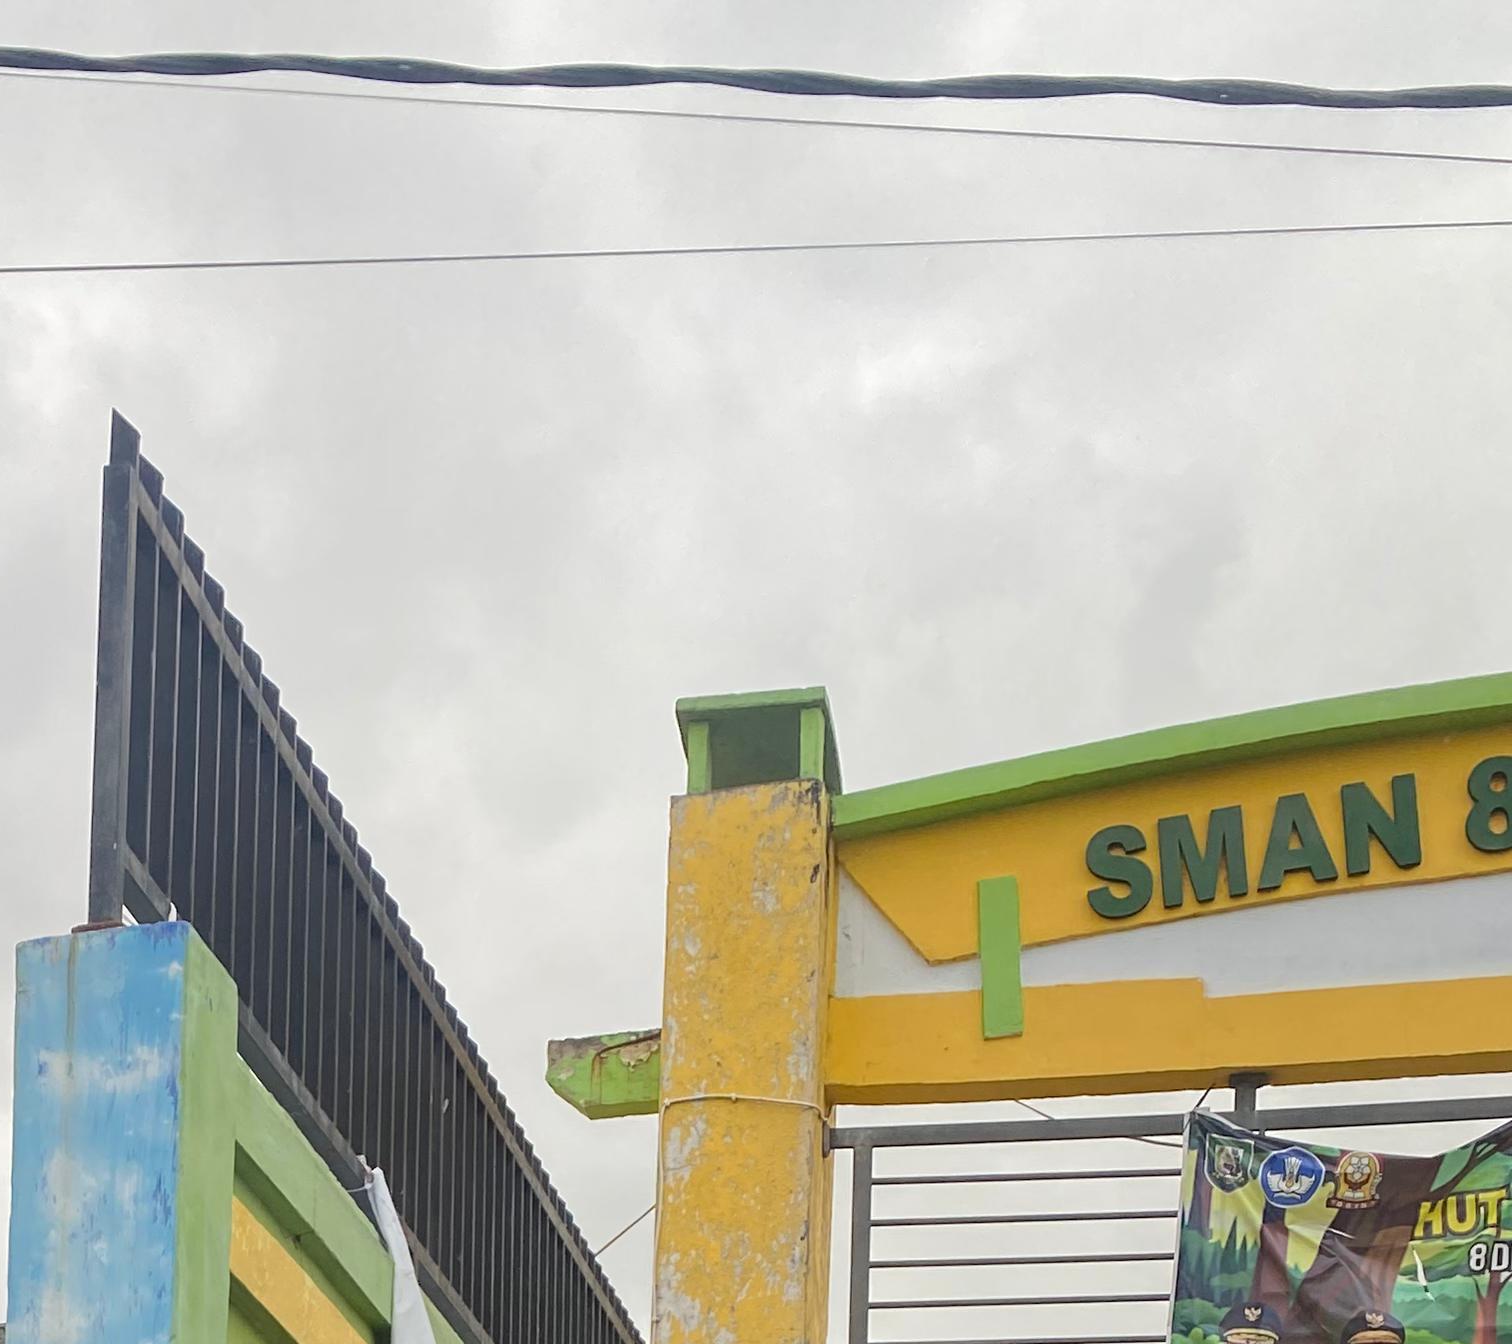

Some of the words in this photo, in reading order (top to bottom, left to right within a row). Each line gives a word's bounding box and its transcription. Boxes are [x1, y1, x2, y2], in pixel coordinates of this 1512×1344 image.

[1085, 773, 1421, 919] SMAN
[1465, 755, 1512, 852] 8
[1414, 1189, 1506, 1236] HUT
